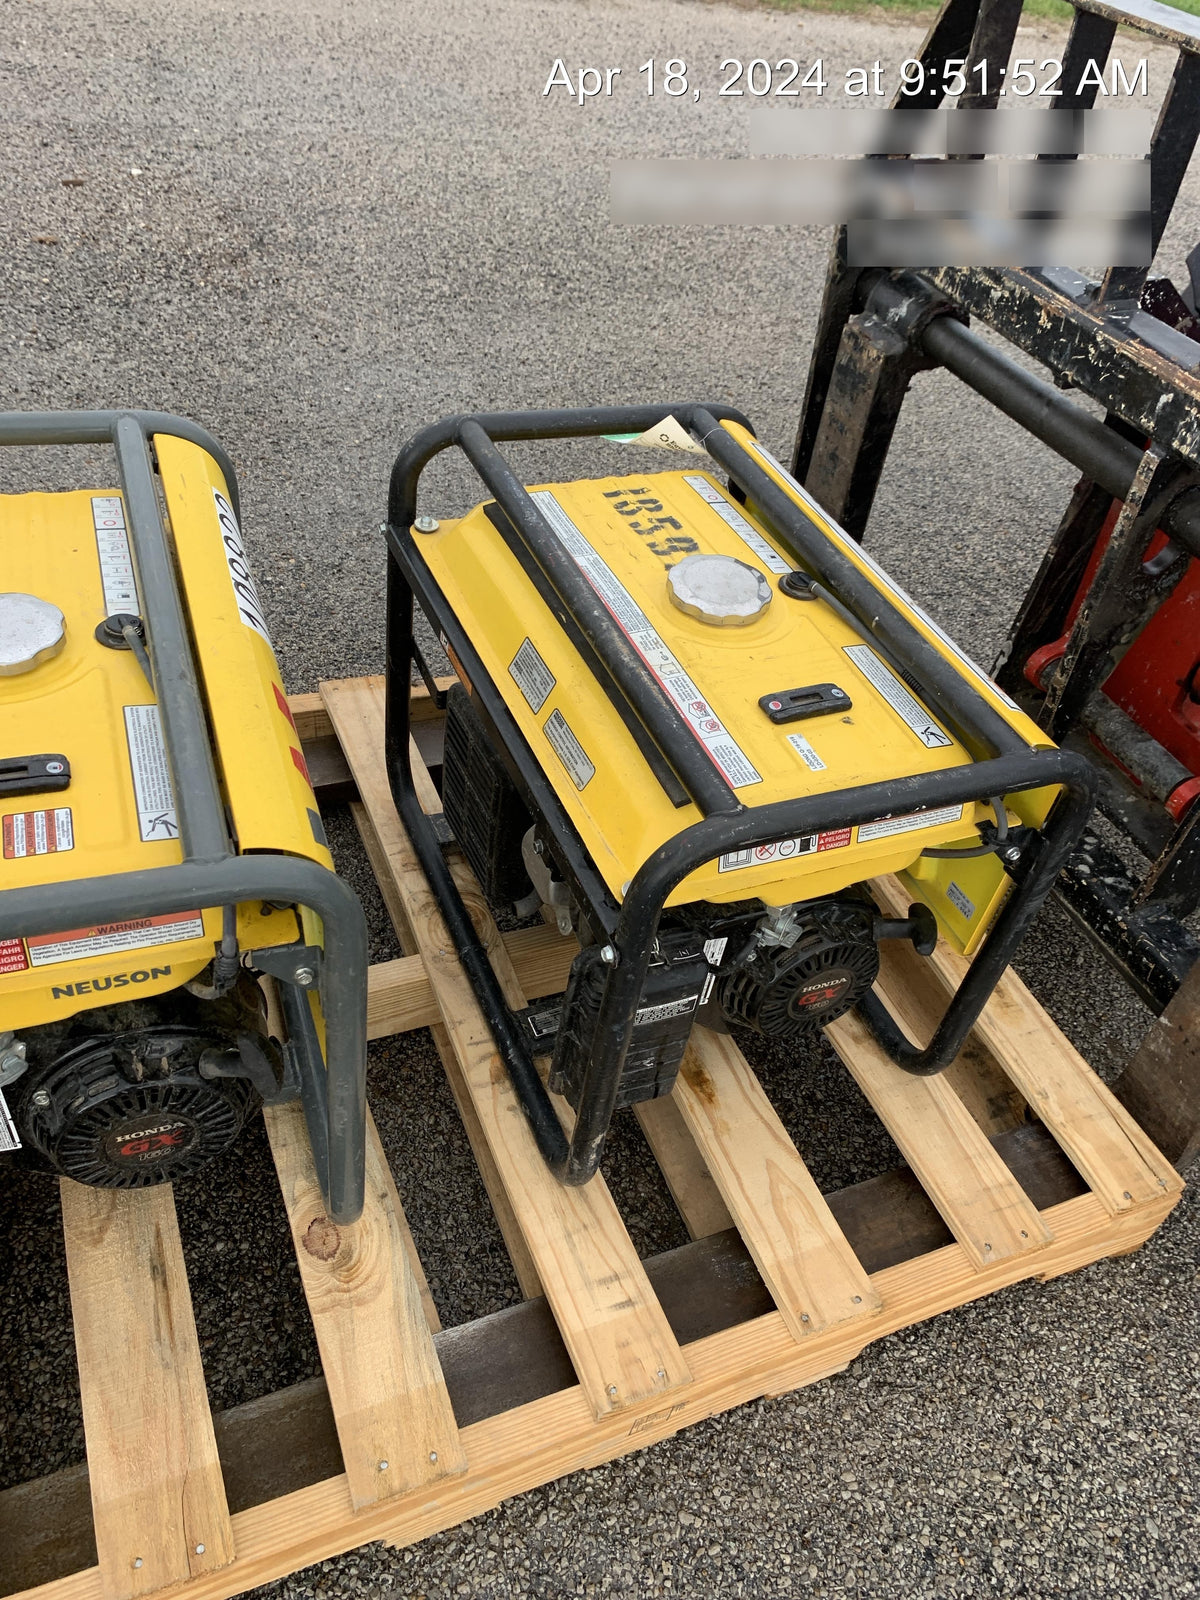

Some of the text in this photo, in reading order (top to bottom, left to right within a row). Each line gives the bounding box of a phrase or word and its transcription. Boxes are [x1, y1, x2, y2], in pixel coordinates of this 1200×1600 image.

[824, 834, 850, 844] PELIGRO
[826, 840, 850, 850] DANGER
[97, 919, 152, 935] WARNING
[0, 939, 19, 947] GER
[0, 963, 24, 973] NGER
[51, 965, 172, 1000] NEUSON
[802, 977, 848, 992] HONDA
[798, 986, 843, 1006] GX
[115, 1122, 186, 1142] HONDA
[120, 1129, 184, 1156] GX
